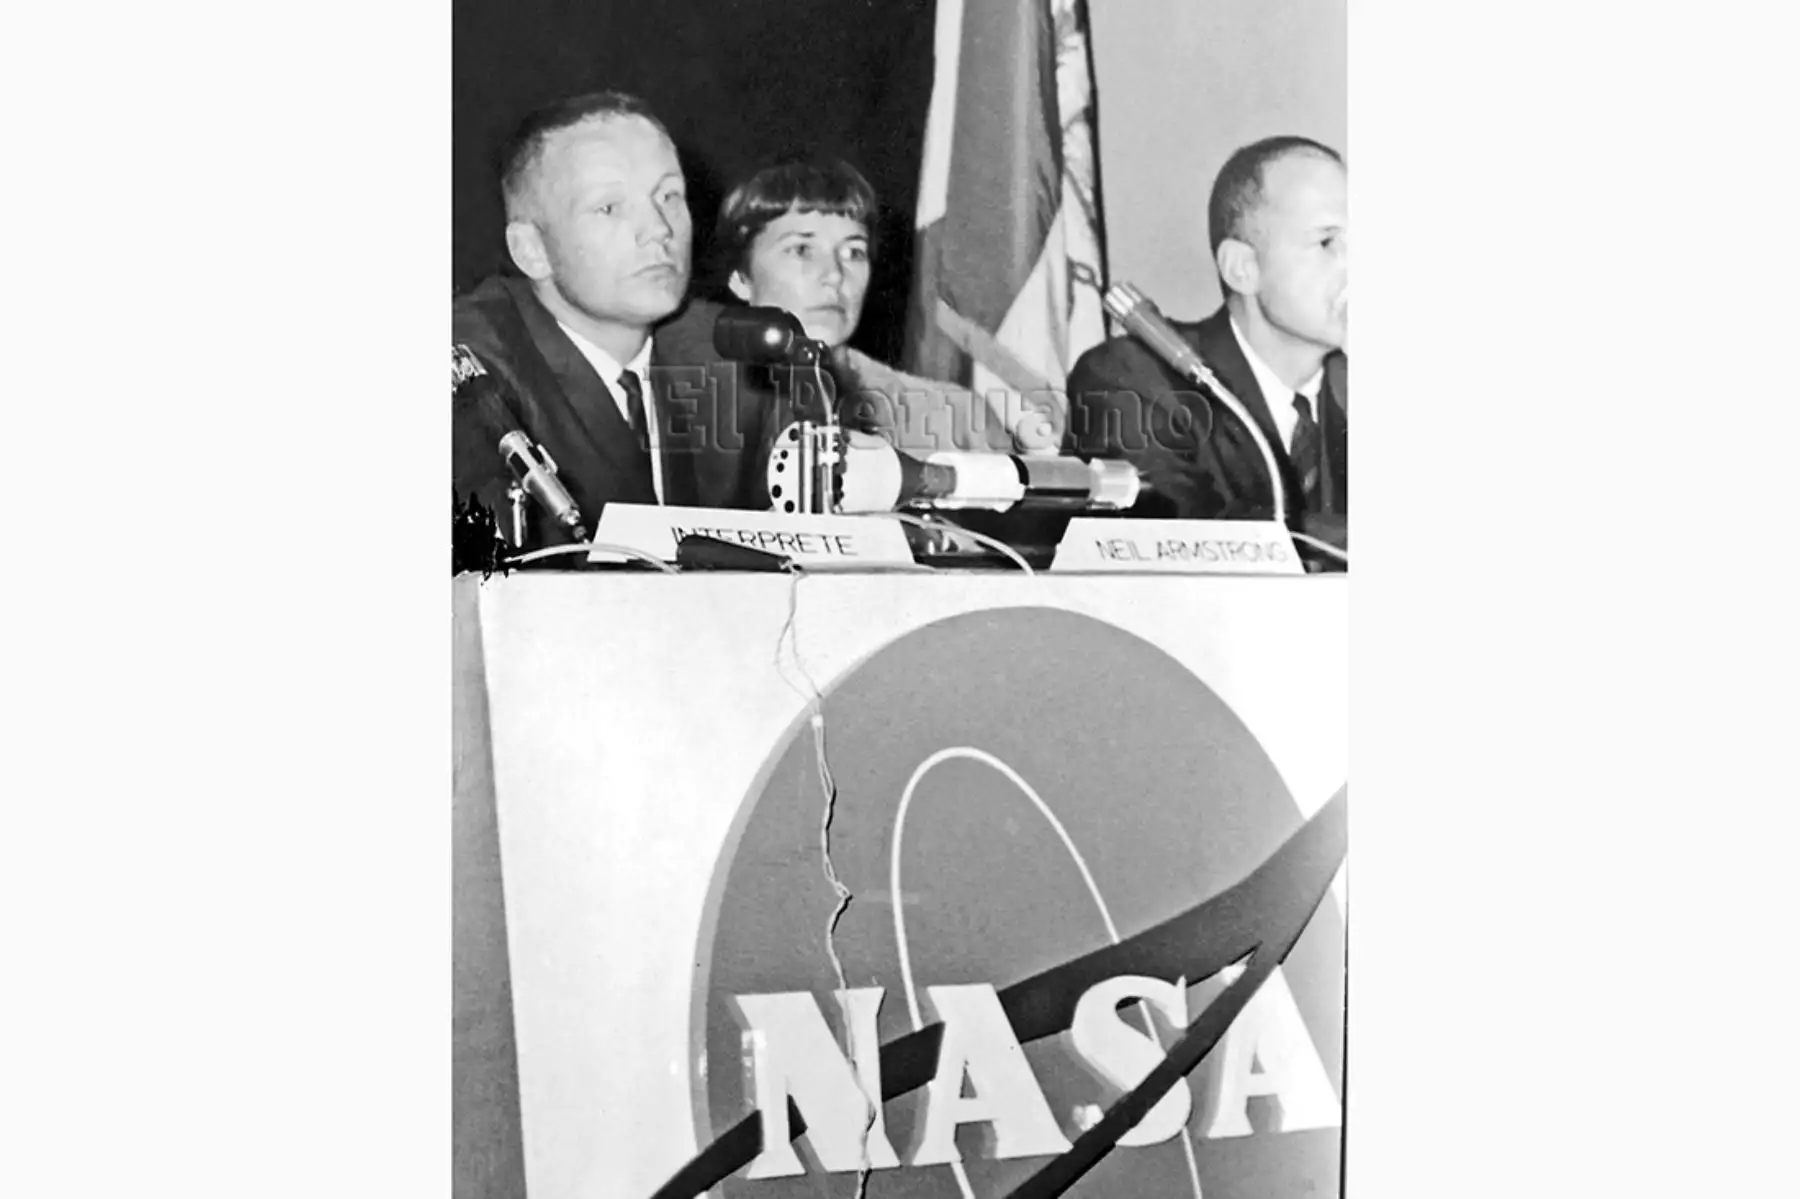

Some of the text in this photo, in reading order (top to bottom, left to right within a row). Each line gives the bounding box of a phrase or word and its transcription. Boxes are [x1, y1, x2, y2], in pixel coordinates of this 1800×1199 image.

[1096, 538, 1289, 564] NEIL ARMSTRONG
[735, 964, 1344, 1179] NASA
